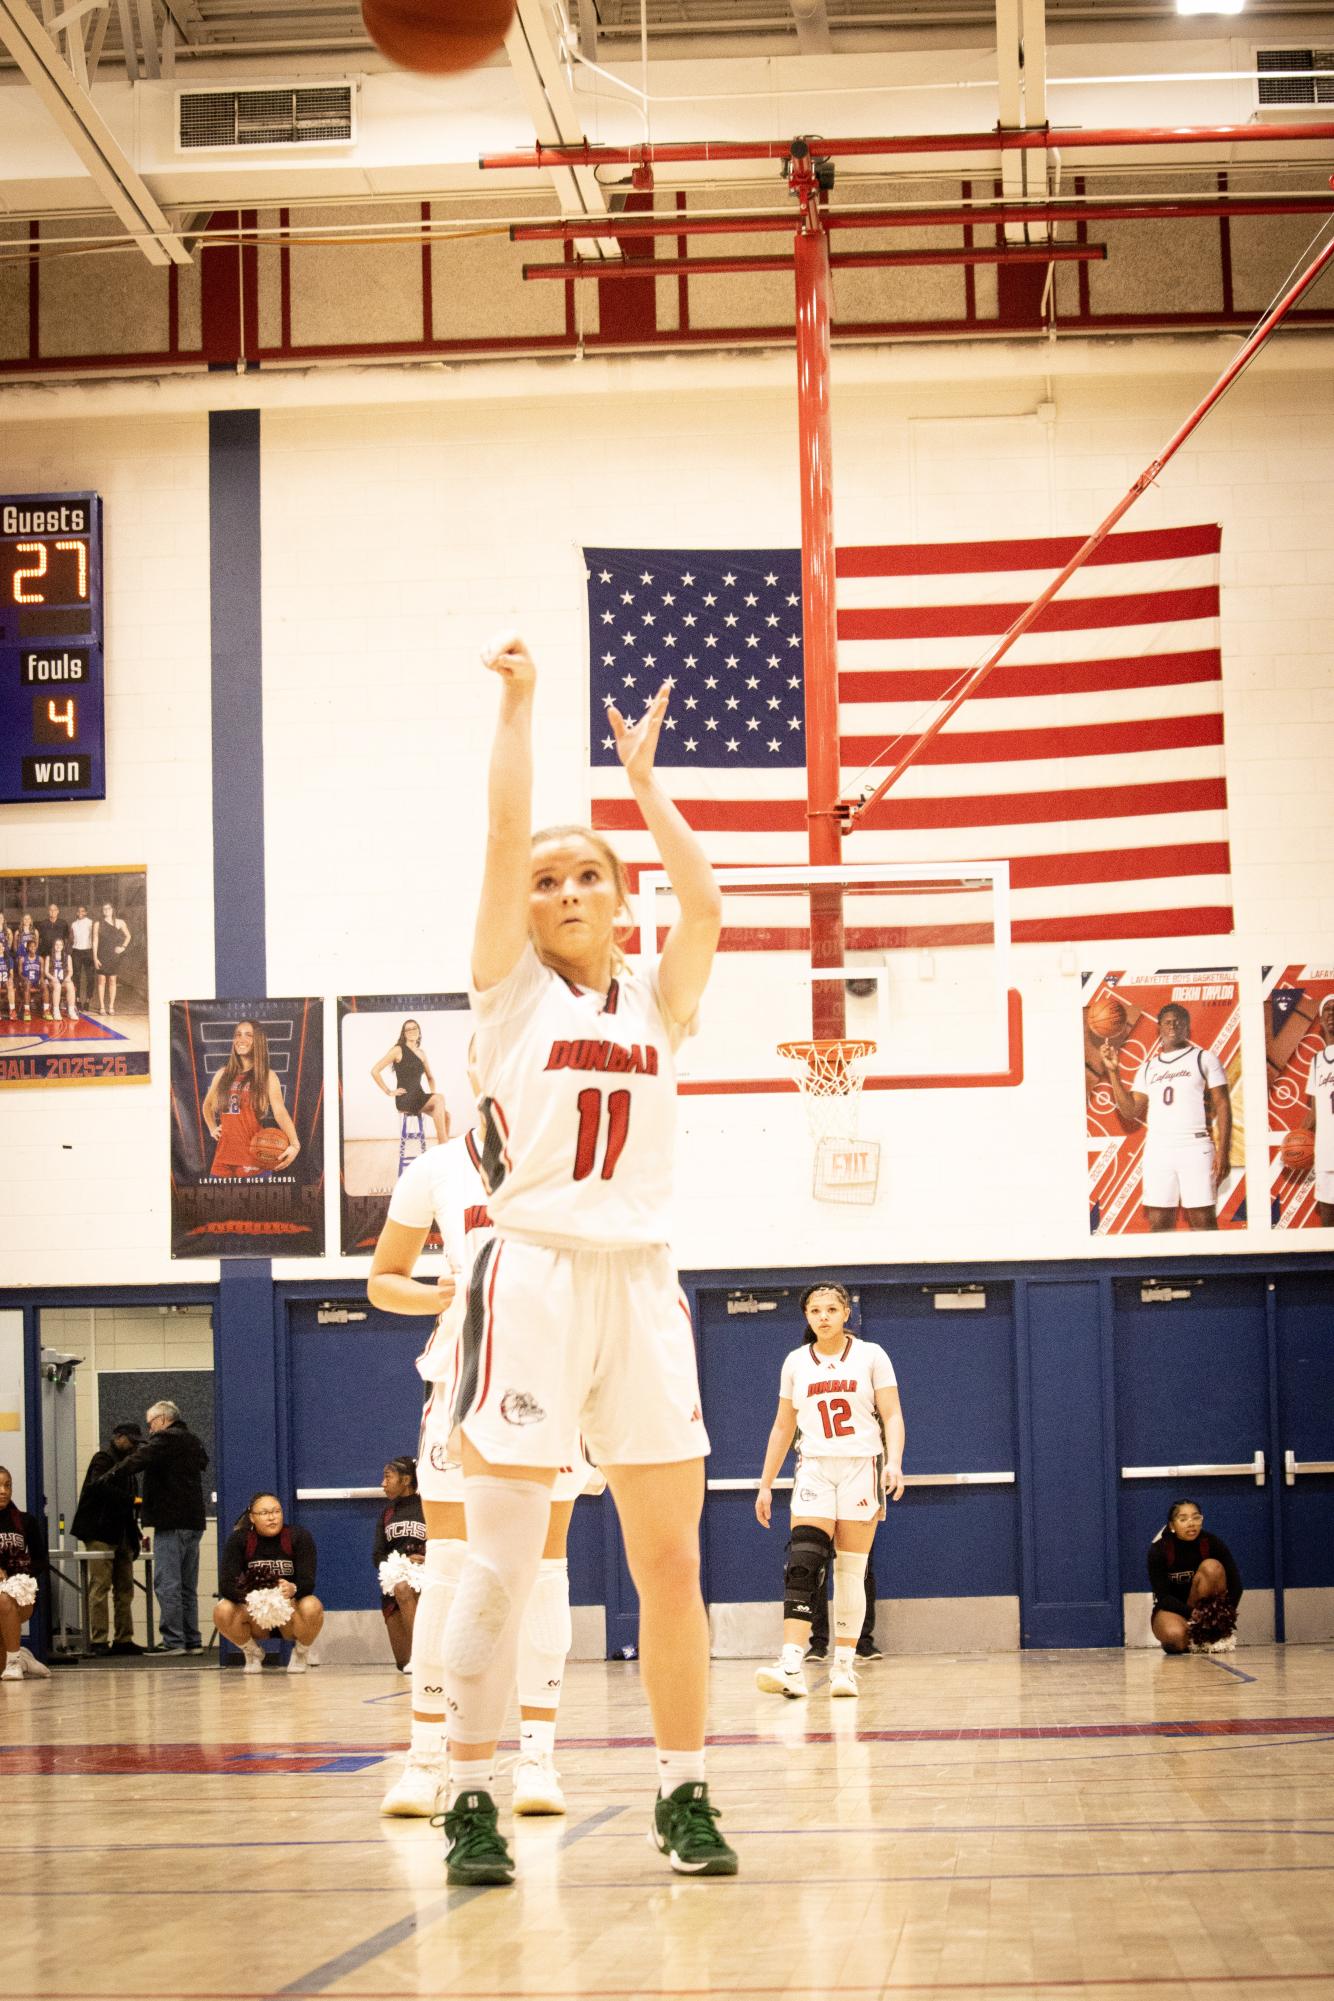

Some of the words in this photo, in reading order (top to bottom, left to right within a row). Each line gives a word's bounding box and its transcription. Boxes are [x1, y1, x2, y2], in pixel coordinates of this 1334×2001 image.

[3, 506, 84, 535] Guests
[13, 540, 87, 604] 27
[48, 699, 75, 738] 4
[29, 970, 36, 980] 5
[1130, 975, 1170, 984] LAFAYETTE
[1172, 974, 1191, 983] BOYS
[1193, 972, 1237, 982] BASKETBALL
[1201, 984, 1235, 1001] TAYLOR
[46, 1056, 128, 1079] 2025-26
[1151, 1070, 1192, 1084] Lafayette
[1163, 1086, 1174, 1106] 0
[573, 1087, 631, 1181] 11
[832, 1152, 868, 1173] EXIT
[199, 1177, 242, 1185] LAFAYETTE
[806, 1379, 857, 1398] DUNBAR
[817, 1398, 855, 1439] 12
[385, 1520, 426, 1542] TCHS
